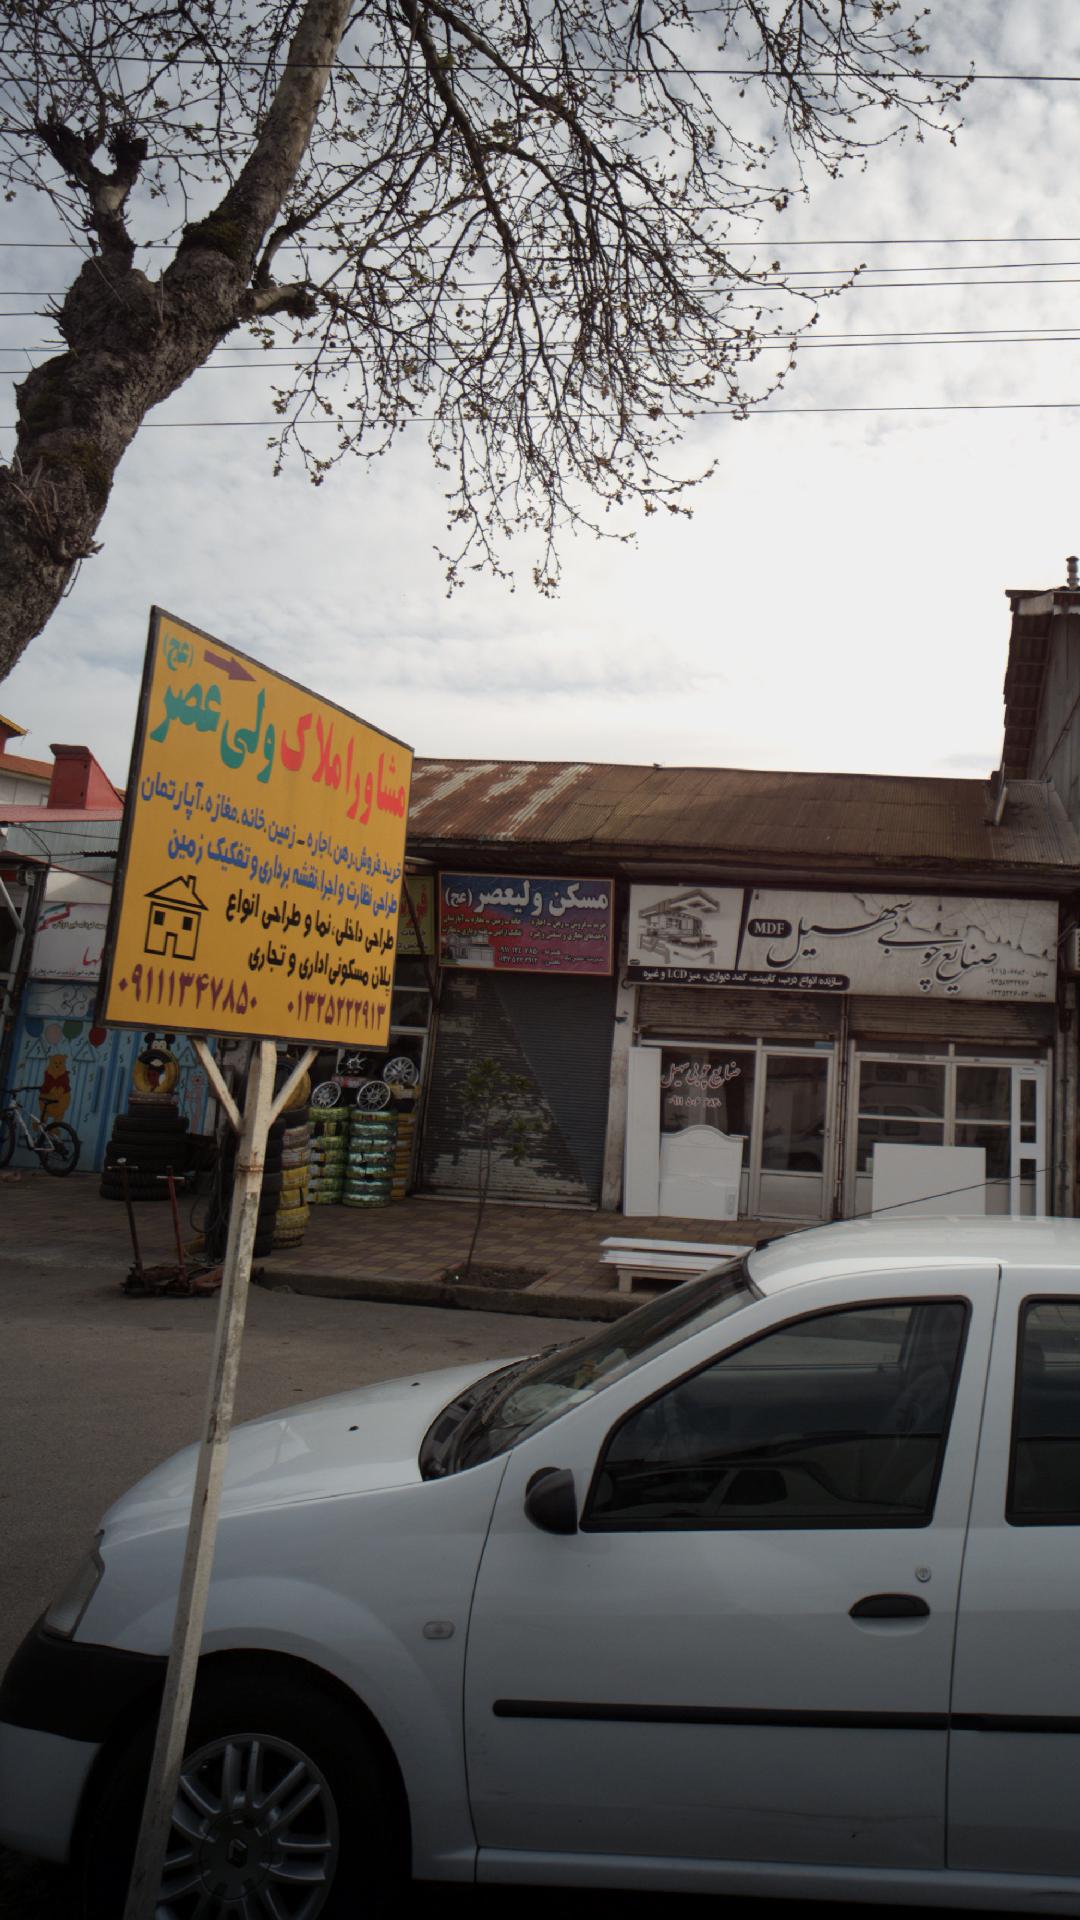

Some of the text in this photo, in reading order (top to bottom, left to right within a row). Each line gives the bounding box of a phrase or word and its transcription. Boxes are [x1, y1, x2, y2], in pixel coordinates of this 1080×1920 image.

[150, 683, 405, 825] مشاور املاک ولی عصر
[141, 771, 203, 821] آپارتمان
[168, 828, 204, 864] زمین
[207, 837, 251, 872] تفکیک
[250, 855, 258, 880] و
[292, 861, 318, 889] نقشه
[226, 888, 260, 924] انواع
[338, 883, 344, 905] و
[346, 881, 373, 910] نظارت
[373, 891, 397, 919] طراحی
[548, 882, 609, 917] مسکن
[262, 900, 301, 932] طراحی
[303, 914, 312, 938] و
[315, 909, 332, 937] نما
[753, 921, 786, 935] MDF
[365, 928, 394, 955] طراحی
[248, 940, 287, 973] تجاری
[287, 952, 296, 977] و
[298, 951, 329, 980] اداری
[936, 939, 998, 991] صنایع
[328, 957, 369, 986] مسکونی
[668, 968, 688, 979] LCD
[118, 963, 258, 1016] ۰۹۱۱۱۳۴۷۸۵۰
